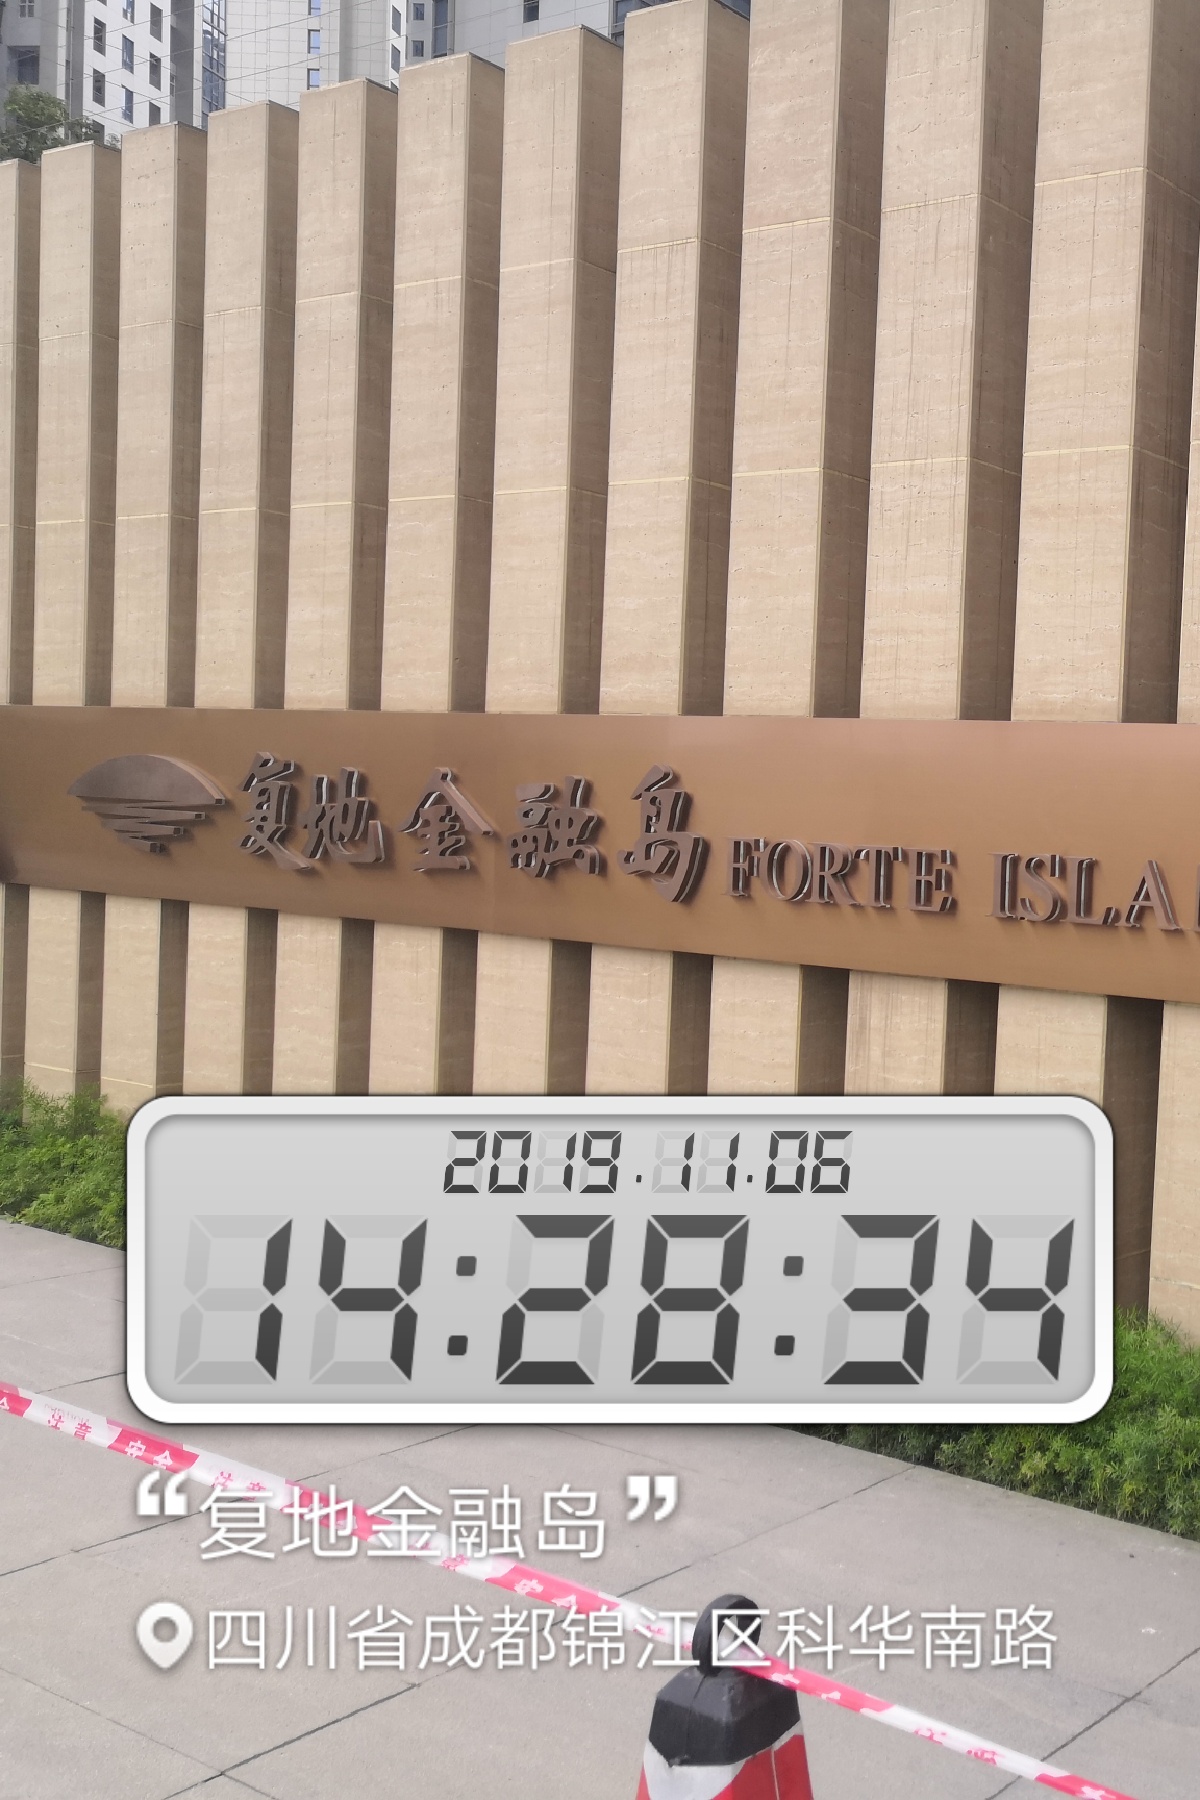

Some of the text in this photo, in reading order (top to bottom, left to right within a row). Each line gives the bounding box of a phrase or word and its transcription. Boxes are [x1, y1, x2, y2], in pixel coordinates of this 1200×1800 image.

[237, 751, 711, 903] 复地金融岛
[725, 836, 956, 913] FORTE
